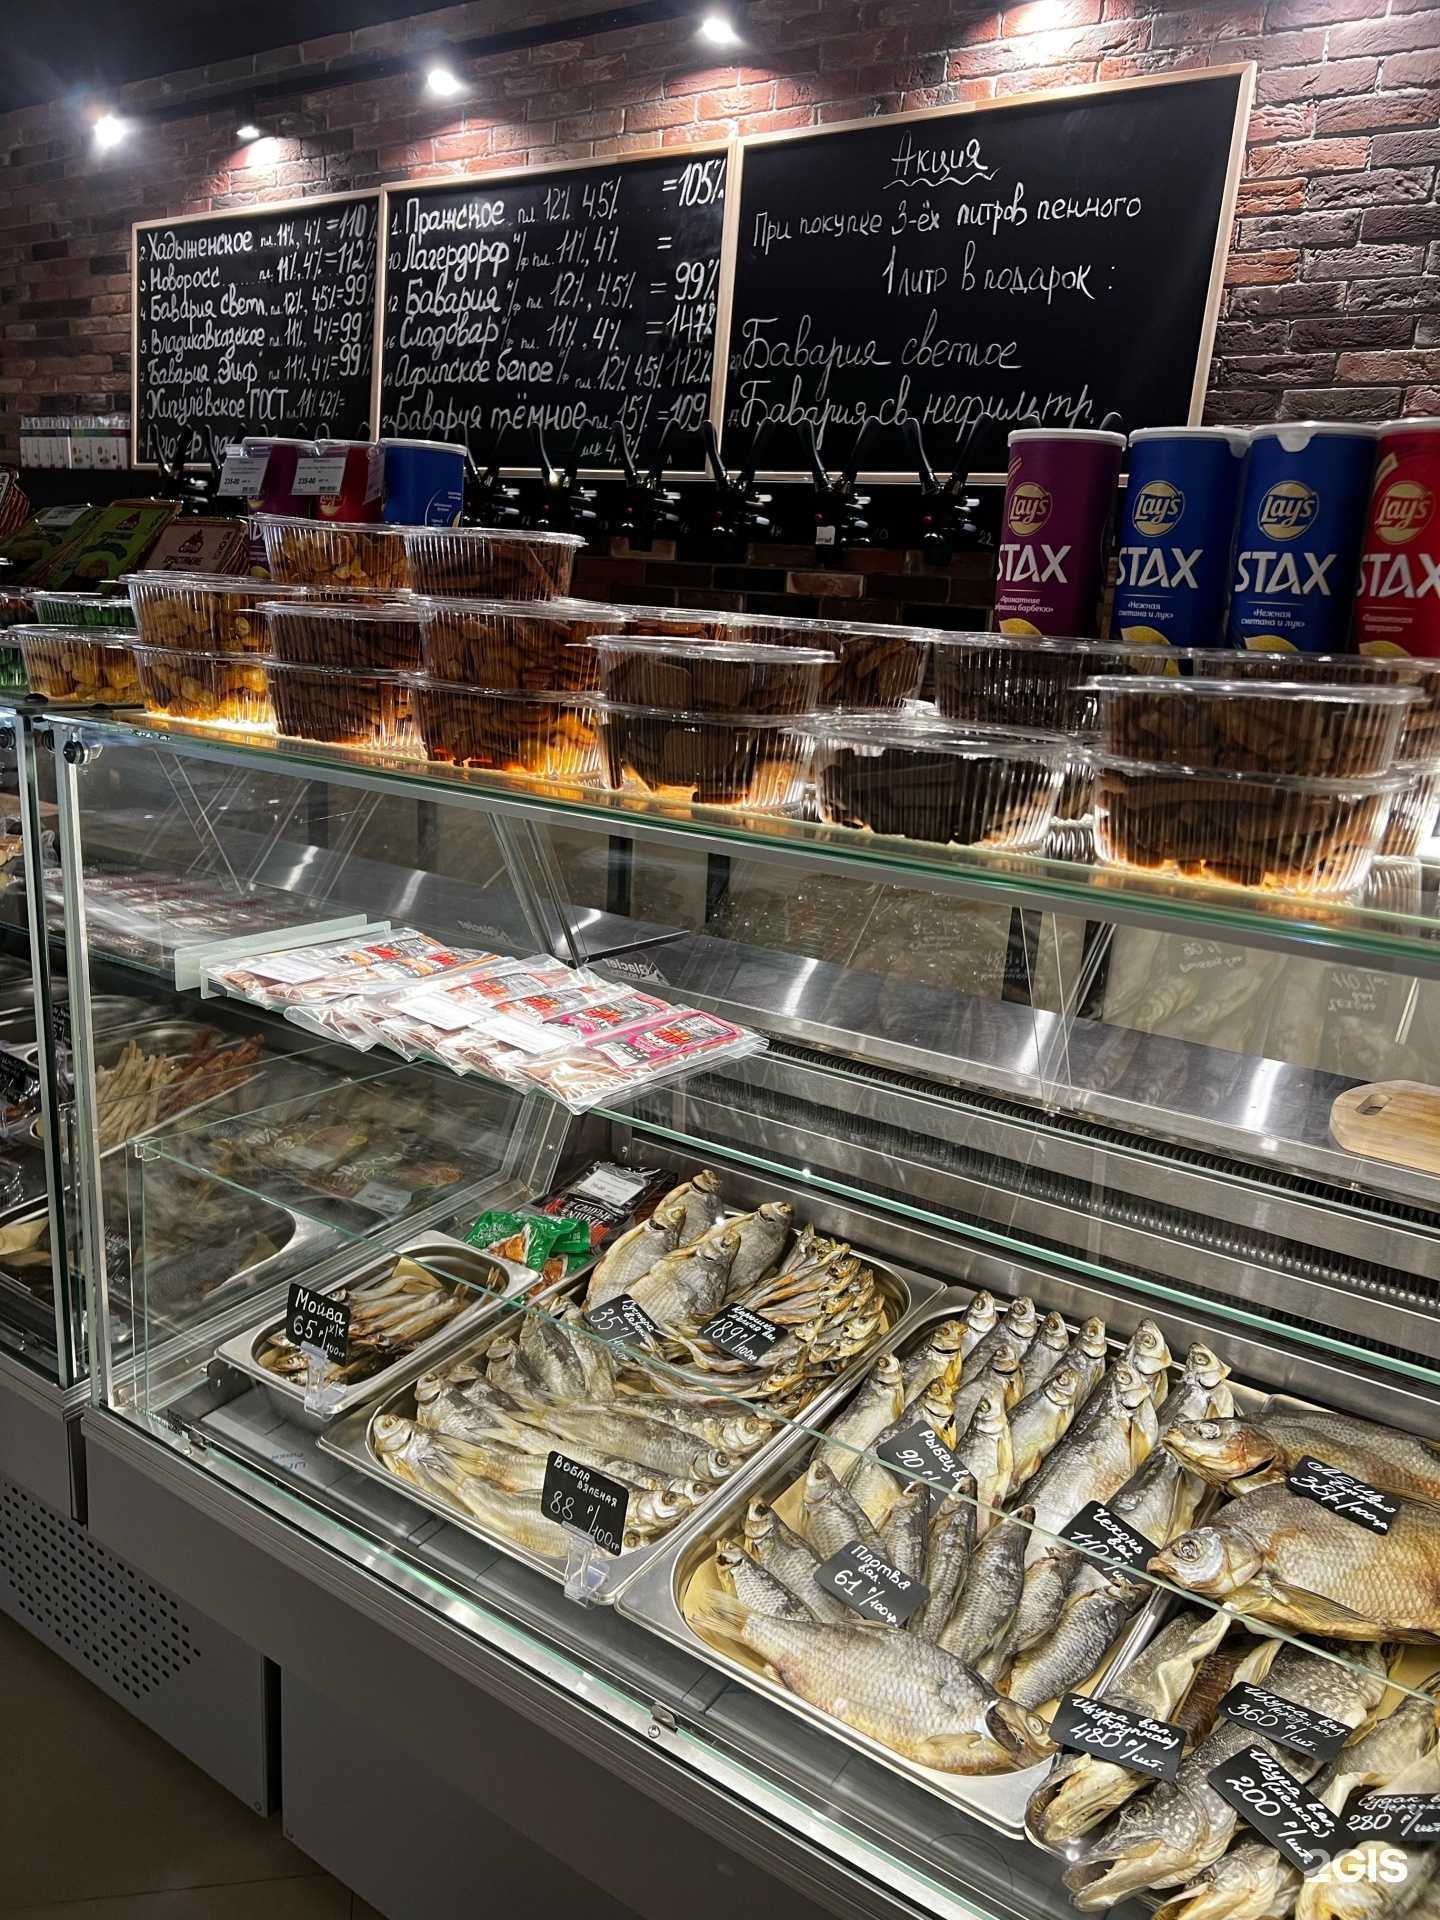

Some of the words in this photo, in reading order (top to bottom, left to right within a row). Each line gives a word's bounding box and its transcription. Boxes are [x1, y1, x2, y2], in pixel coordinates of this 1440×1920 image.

[891, 130, 990, 181] Акция
[406, 198, 505, 246] Пражское
[753, 211, 793, 255] При
[799, 213, 883, 238] покупке
[956, 182, 1029, 235] литров
[1037, 196, 1142, 221] пенного
[147, 230, 254, 261] Хадыженское
[401, 233, 510, 283] Лагердорф
[150, 262, 220, 302] Новоросс
[882, 244, 896, 294] 1
[899, 267, 948, 297] литр
[962, 239, 976, 291] в
[984, 264, 1097, 304] подарок
[150, 293, 217, 333] Бавария
[405, 273, 501, 319] Бавария
[496, 347, 554, 383] белое
[742, 314, 891, 402] Бавария
[901, 308, 1022, 369] светлое
[147, 357, 210, 398] Бавария
[146, 385, 246, 426] Жигулёвское
[249, 387, 289, 420] ГОСТ
[394, 388, 482, 440] Бавария
[490, 392, 586, 430] тёмное
[739, 374, 869, 450] Бавария
[1008, 492, 1049, 525] Lay's
[1132, 490, 1182, 526] Lay's
[1259, 490, 1316, 528] Lay's
[1375, 492, 1431, 530] Lay's
[996, 543, 1072, 584] STAX
[1116, 546, 1204, 590] STAX
[1234, 550, 1338, 597] STAX
[1355, 553, 1440, 599] STAX
[295, 1288, 346, 1325] Мойва
[590, 1308, 624, 1330] 35
[293, 1315, 318, 1339] 65
[703, 1318, 744, 1343] 189
[896, 1449, 925, 1468] 90
[550, 1490, 575, 1520] 88
[834, 1569, 863, 1596] 61
[851, 1544, 911, 1591] Плотва
[1072, 1698, 1131, 1724] Щука
[1228, 1703, 1279, 1727] 360
[1244, 1686, 1312, 1721] Щука
[1070, 1722, 1123, 1748] 480
[1249, 1748, 1301, 1799] Щука
[1225, 1775, 1281, 1817] 200
[1346, 1813, 1392, 1832] 280
